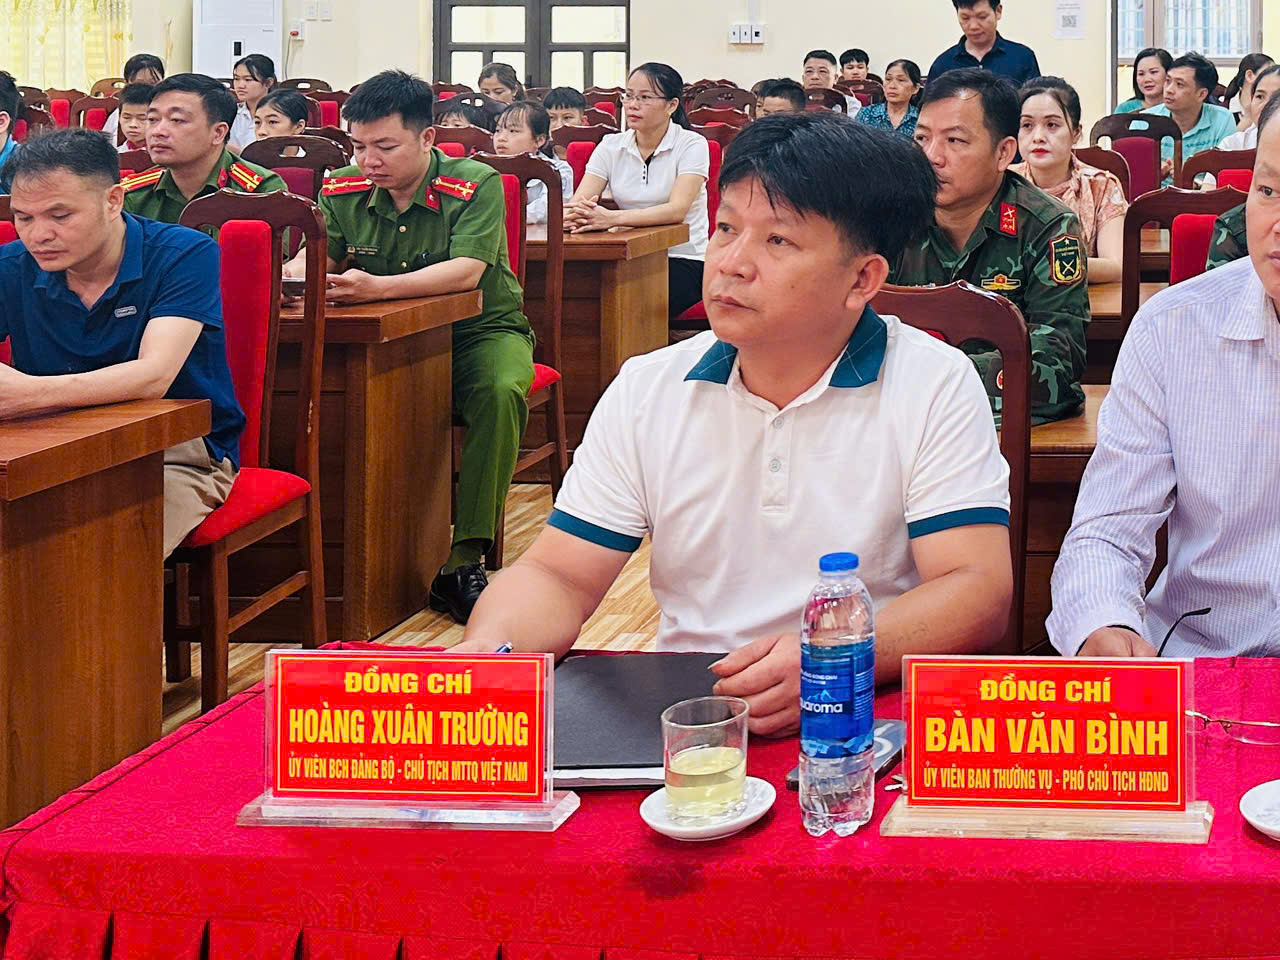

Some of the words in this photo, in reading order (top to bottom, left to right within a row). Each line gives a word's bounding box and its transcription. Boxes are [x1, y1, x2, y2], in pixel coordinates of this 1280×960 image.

[344, 665, 418, 694] ĐỒNG
[427, 669, 472, 695] CHÍ
[979, 673, 1056, 702] ĐỒNG
[1065, 676, 1112, 703] CHÍ
[289, 702, 364, 744] HOÀNG
[372, 703, 433, 745] XUÂN
[440, 703, 528, 746] TRƯỜNG
[925, 710, 995, 752] BÀN
[1006, 711, 1074, 754] VĂN
[1087, 713, 1168, 756] BÌNH
[288, 751, 301, 778] ỦY
[303, 753, 327, 778] VIÊN
[329, 758, 349, 779] BCH
[351, 752, 379, 780] ĐẢNG
[381, 755, 395, 784] BỘ
[405, 753, 424, 781] CHỦ
[427, 760, 449, 785] TỊCH
[452, 760, 479, 784] MTTQ
[481, 757, 503, 786] VIỆT
[504, 761, 528, 782] NAM
[923, 760, 938, 788] ỦY
[940, 763, 965, 788] VIÊN
[967, 768, 990, 789] BAN
[993, 763, 1036, 790] THƯỜNG
[1038, 769, 1053, 795] VỤ
[1063, 765, 1085, 791] PHÓ
[1087, 763, 1109, 791] CHỦ
[1112, 770, 1136, 797] TỊCH
[1139, 771, 1169, 792] HĐND
